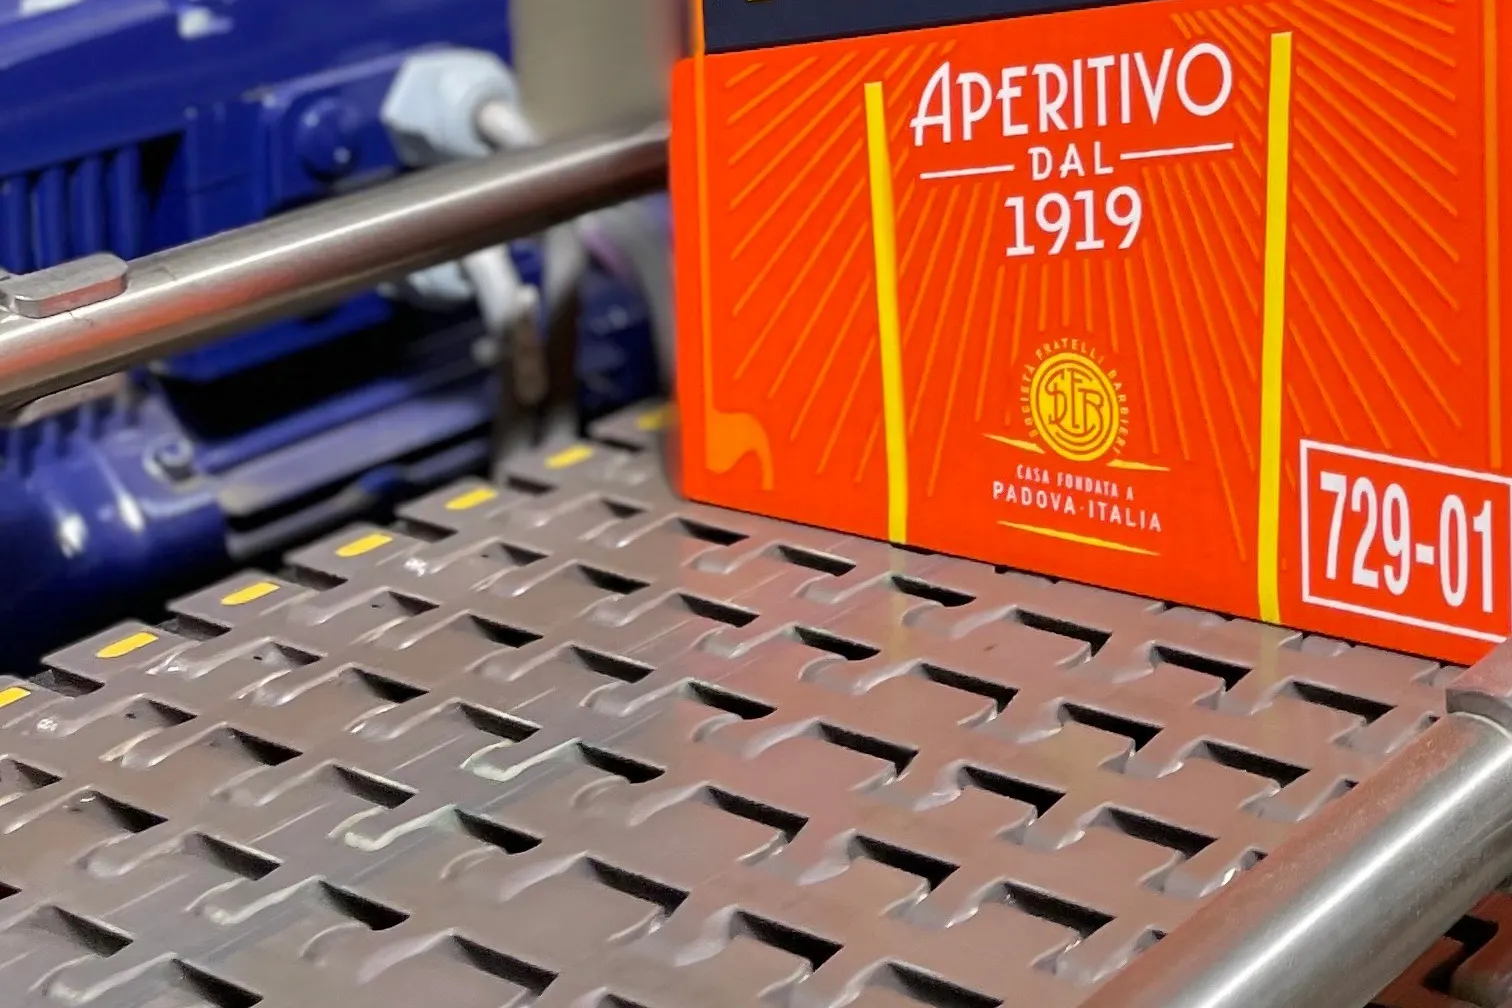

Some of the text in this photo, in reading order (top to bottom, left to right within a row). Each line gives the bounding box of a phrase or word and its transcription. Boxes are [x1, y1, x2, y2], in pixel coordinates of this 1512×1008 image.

[909, 42, 1233, 147] APERITIVO
[1027, 141, 1114, 182] DAL
[1003, 185, 1143, 257] 1919
[992, 480, 1162, 533] PADOVA ITALIA
[1016, 463, 1135, 502] CASA FONDATA A
[1319, 470, 1494, 614] 729-01
